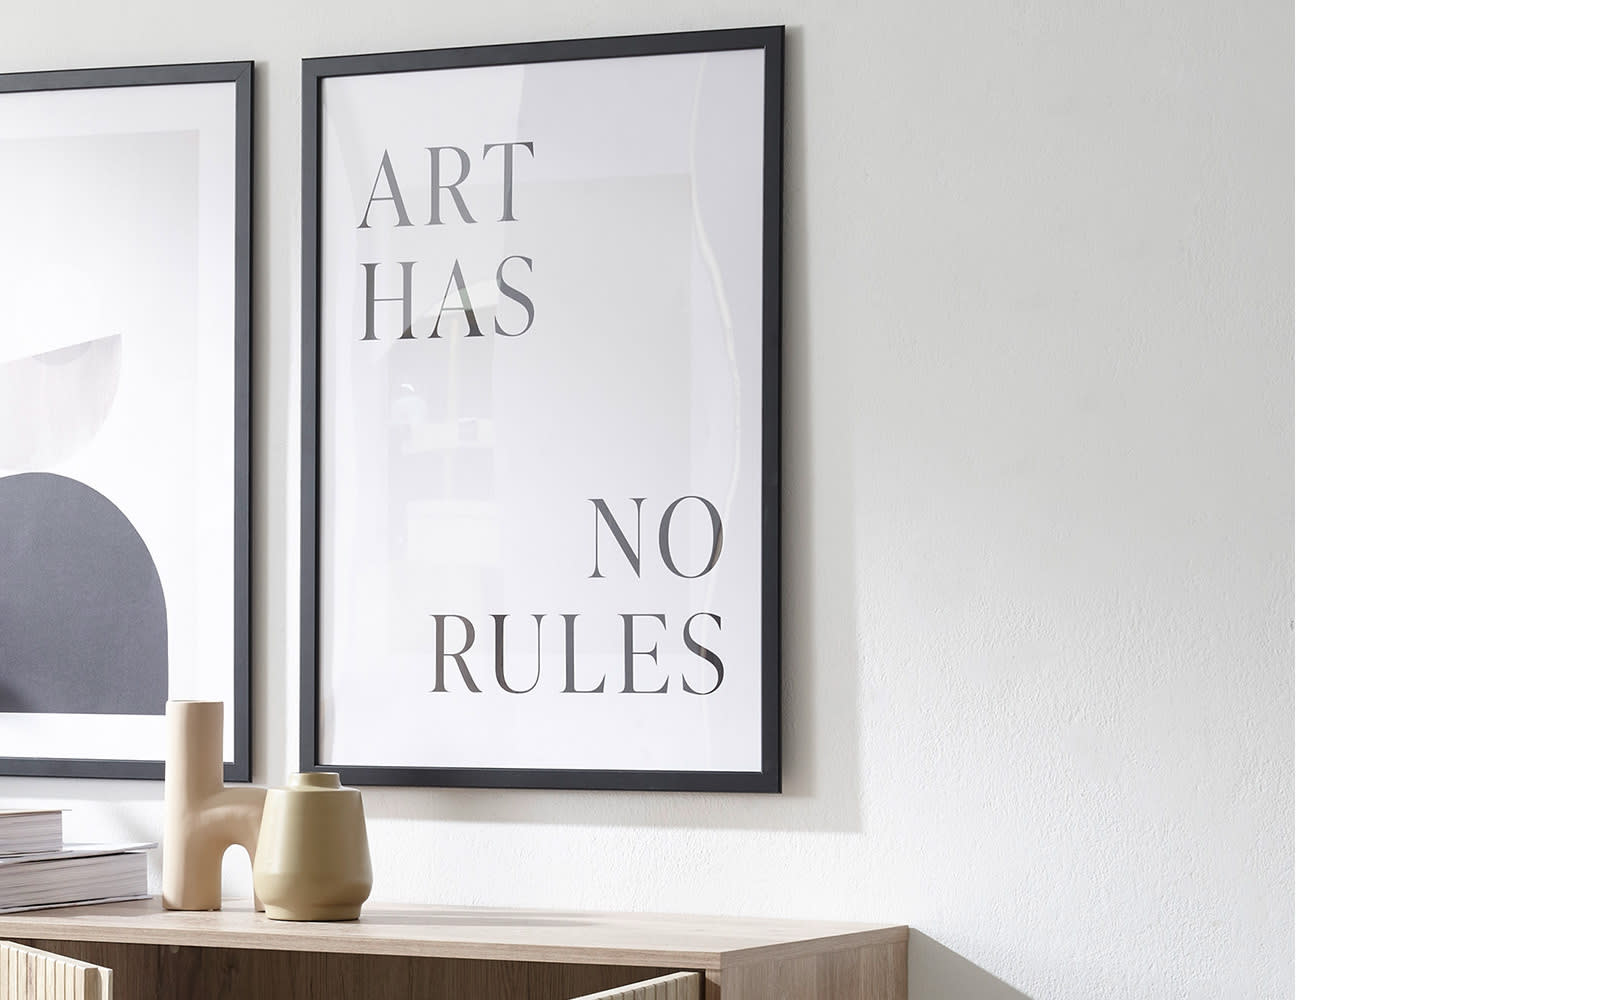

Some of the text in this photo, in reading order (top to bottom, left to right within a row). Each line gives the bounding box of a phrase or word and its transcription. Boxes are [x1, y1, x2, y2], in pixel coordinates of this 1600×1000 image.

[357, 141, 535, 229] ART
[359, 254, 536, 341] HAS
[587, 495, 724, 579] NO
[429, 612, 725, 695] RULES
